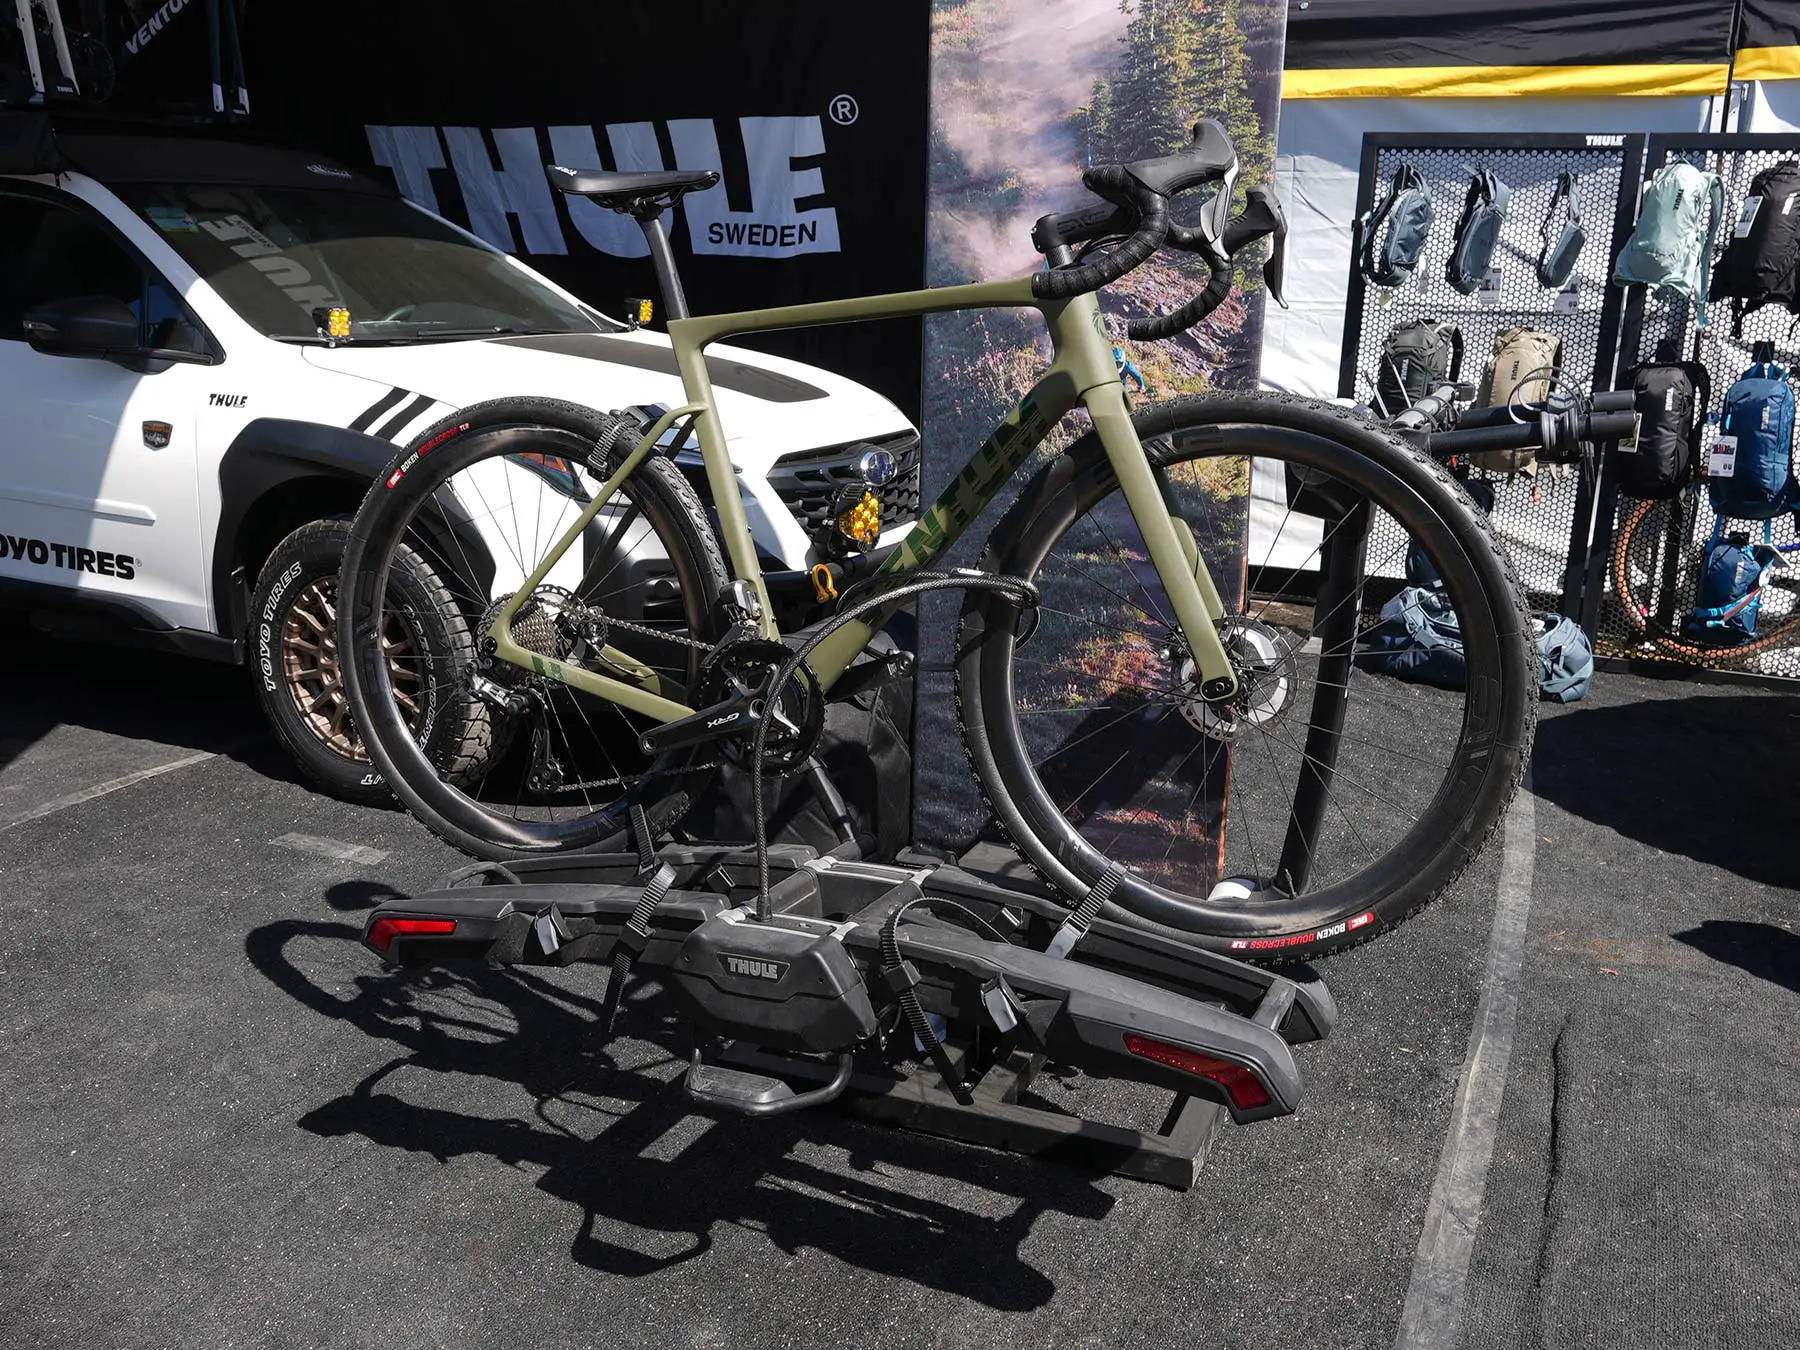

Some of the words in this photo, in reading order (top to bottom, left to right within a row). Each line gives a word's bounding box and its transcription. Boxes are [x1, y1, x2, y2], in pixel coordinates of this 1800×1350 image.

[124, 0, 190, 54] VENTU
[1585, 135, 1626, 146] THULE
[365, 115, 841, 258] THULE
[708, 220, 817, 246] SWEDEN
[198, 214, 347, 318] HULE
[1510, 360, 1520, 381] THULE
[209, 394, 248, 408] THULE
[400, 452, 419, 473] BOKEN
[50, 543, 135, 580] TIRES
[262, 561, 302, 621] TIRES
[259, 624, 277, 692] TOYO
[417, 676, 438, 752] COUNT
[1250, 932, 1316, 949] DOUBLECROSS
[1316, 922, 1346, 941] BOKEN
[1232, 939, 1248, 949] TLR
[727, 957, 778, 980] THULE
